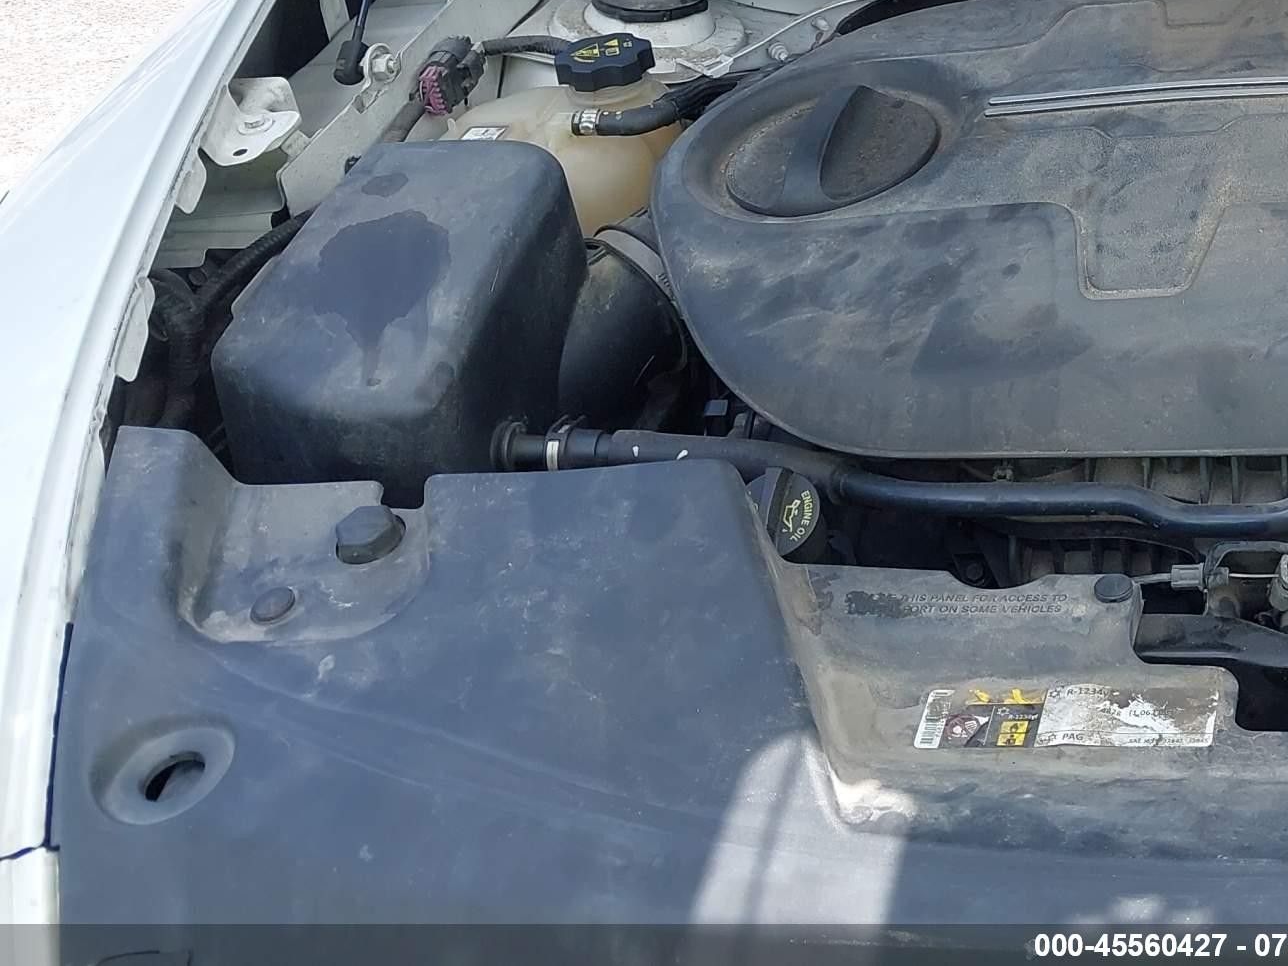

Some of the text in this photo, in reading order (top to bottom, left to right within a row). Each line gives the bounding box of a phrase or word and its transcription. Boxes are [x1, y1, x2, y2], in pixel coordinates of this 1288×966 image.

[789, 490, 813, 542] ENGINE OIL
[901, 593, 927, 603] THIS
[930, 593, 969, 603] PANEL
[972, 593, 997, 603] FOR
[998, 593, 1049, 603] ACCESS
[1052, 593, 1069, 603] TO
[939, 605, 958, 614] ON
[960, 605, 1000, 614] SOME
[1002, 605, 1062, 614] VEHICLES
[1062, 733, 1085, 741] PAG
